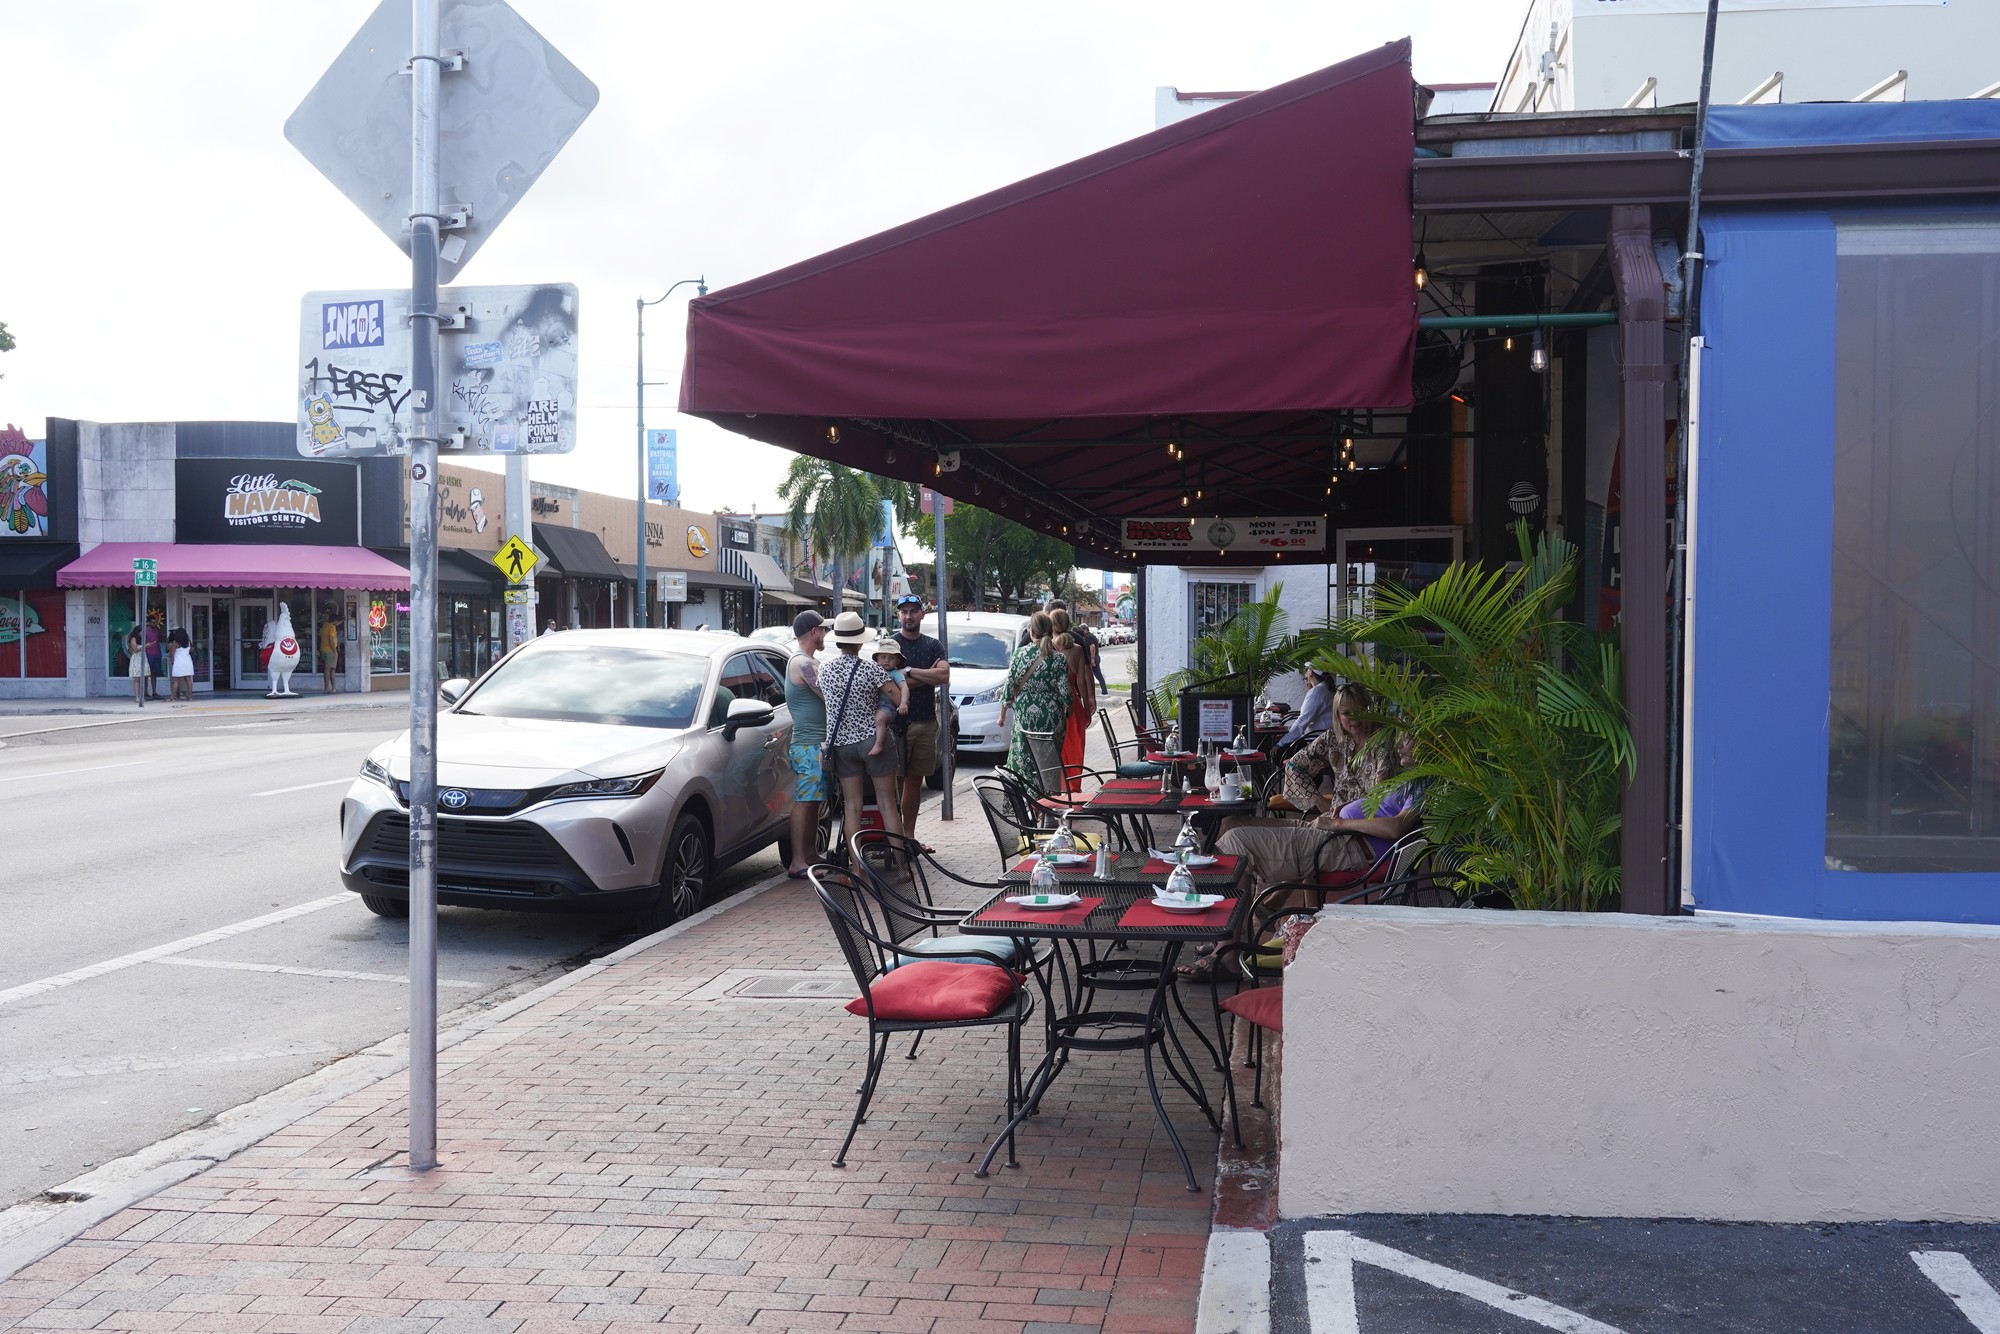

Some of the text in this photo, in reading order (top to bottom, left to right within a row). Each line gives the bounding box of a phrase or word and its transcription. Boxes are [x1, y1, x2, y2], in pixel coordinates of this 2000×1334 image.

[528, 400, 558, 412] ARE
[528, 411, 558, 425] HELM
[528, 424, 558, 437] PORNO
[226, 473, 278, 494] Little
[225, 489, 321, 522] HAVANA
[228, 515, 269, 526] VISITORS
[272, 514, 306, 524] CENTER
[1126, 520, 1191, 531] HAPPY
[1126, 530, 1193, 540] HOUR
[142, 560, 149, 569] 16
[146, 572, 151, 580] 8
[87, 616, 101, 625] 1600
